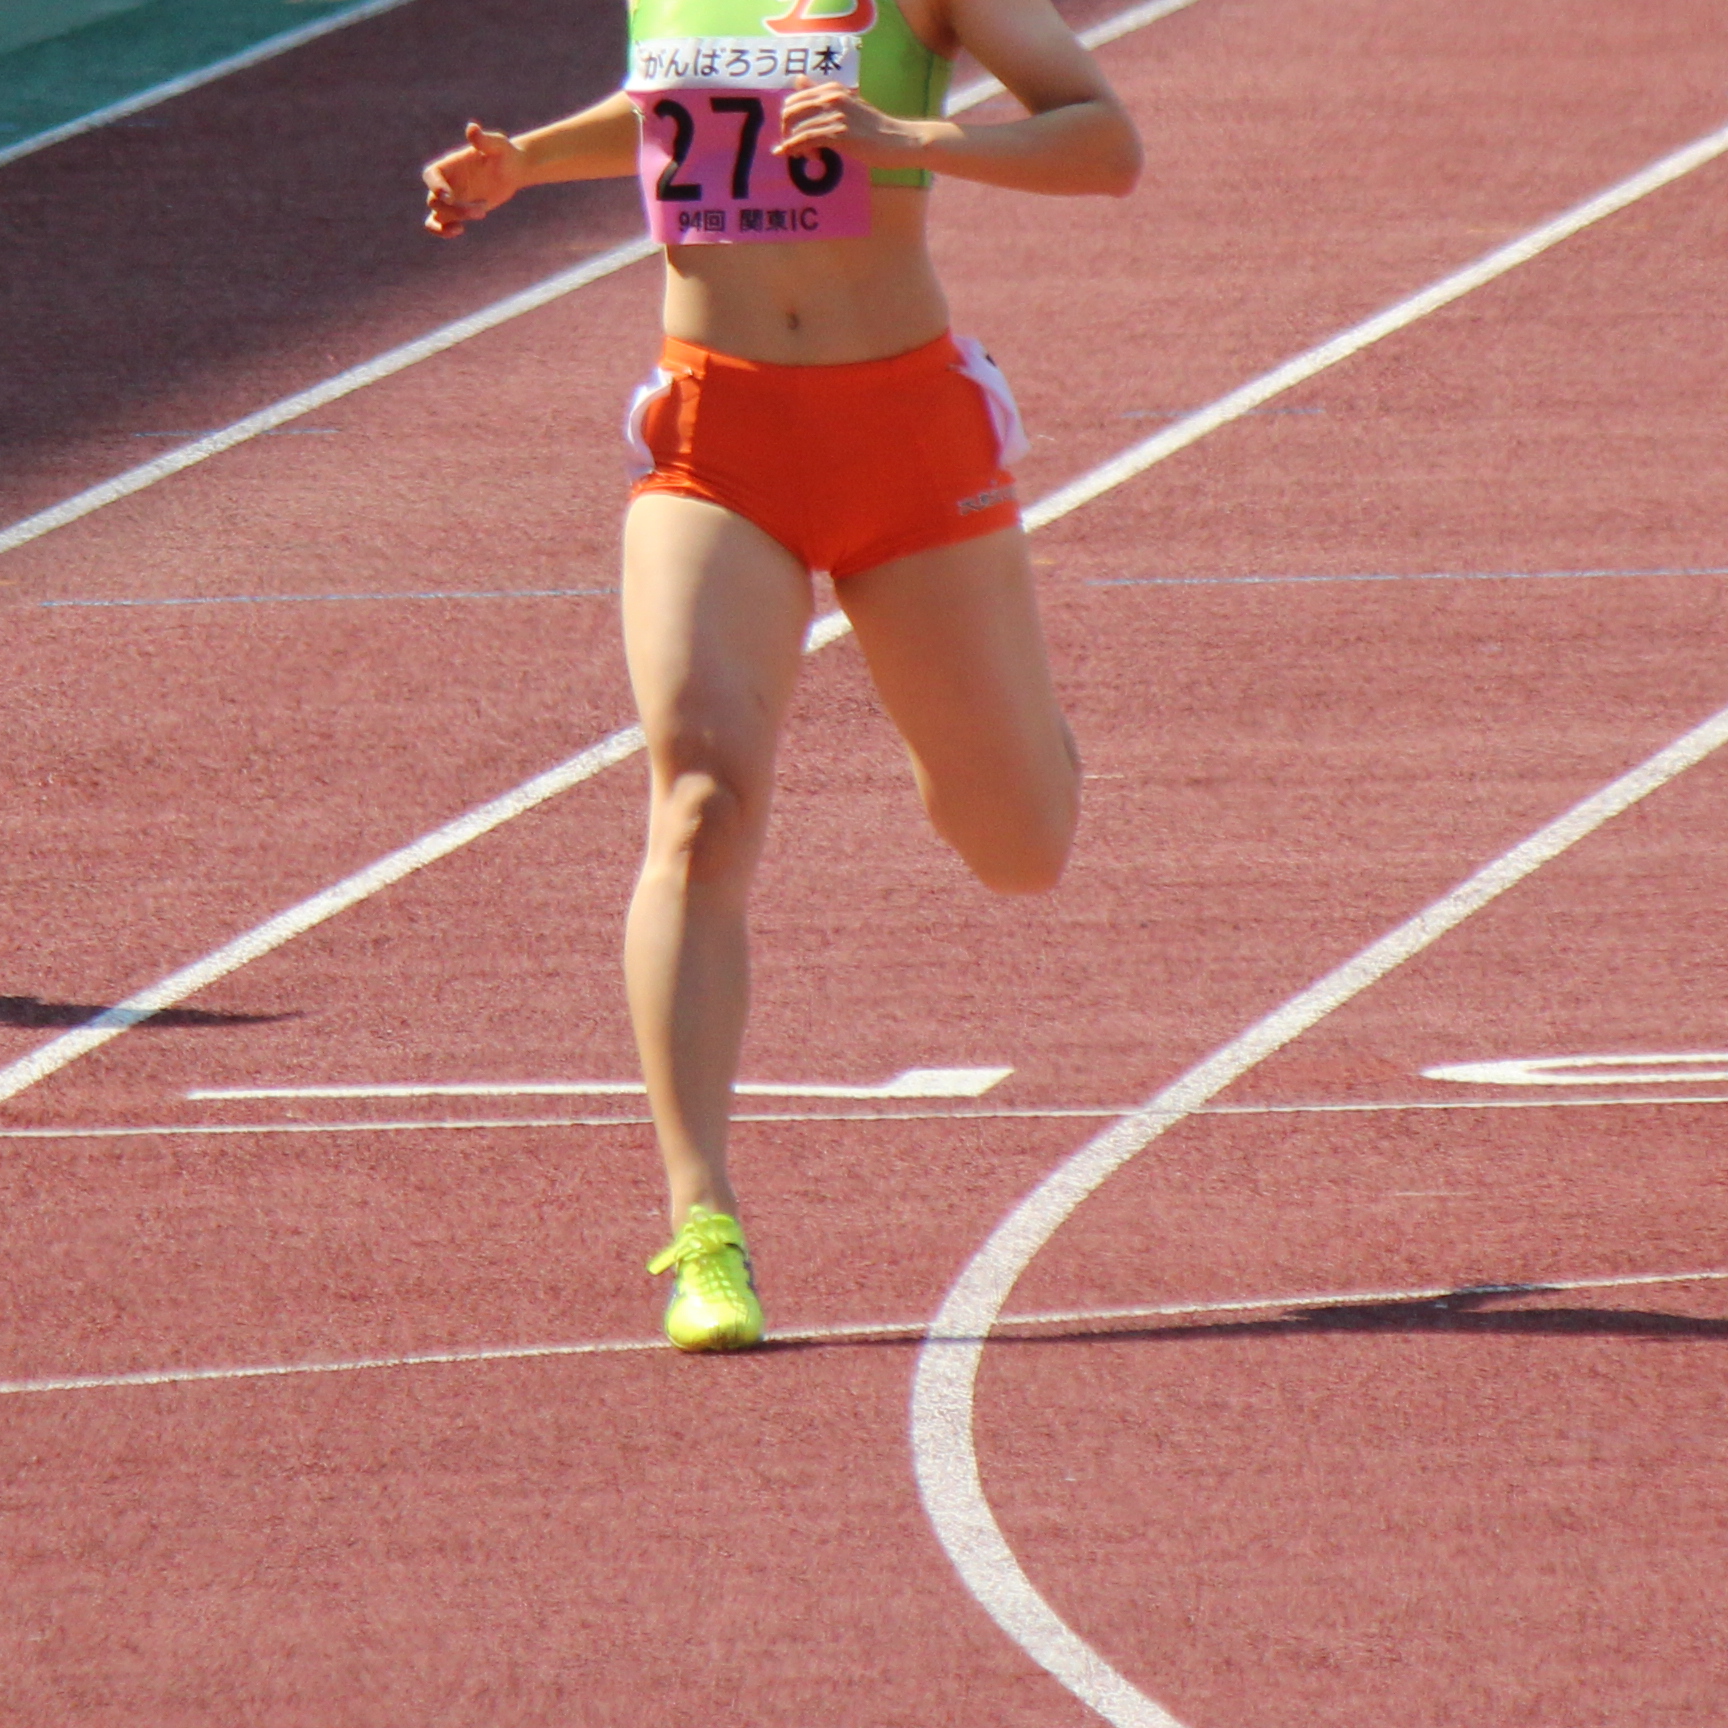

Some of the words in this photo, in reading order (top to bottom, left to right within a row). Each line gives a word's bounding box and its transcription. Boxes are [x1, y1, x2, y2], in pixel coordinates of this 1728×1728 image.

[645, 47, 842, 79] がんばろう日本
[678, 210, 726, 233] 94回
[739, 206, 820, 233] 関東IC
